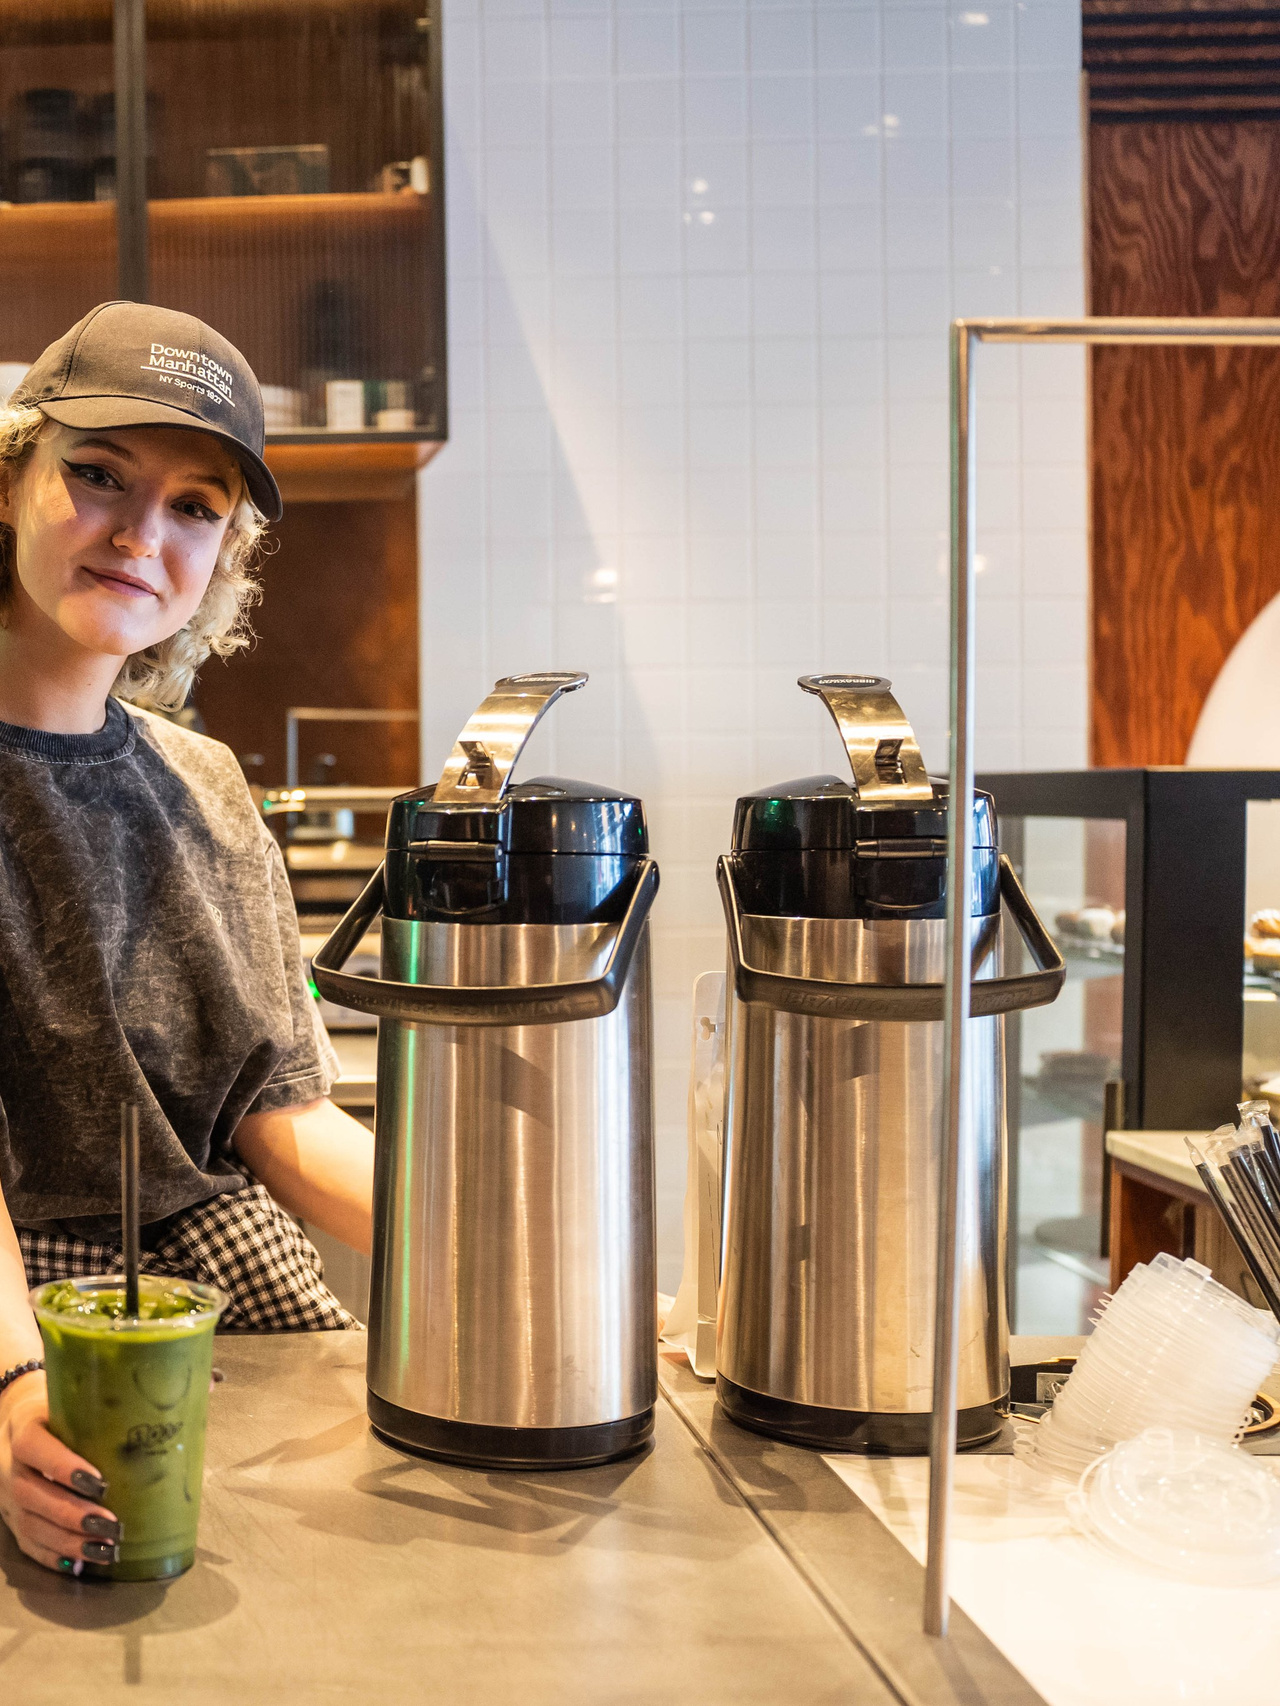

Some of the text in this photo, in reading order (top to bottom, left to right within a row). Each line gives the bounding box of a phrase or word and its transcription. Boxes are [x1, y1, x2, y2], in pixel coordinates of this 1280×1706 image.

[148, 355, 232, 398] Manhattan
[150, 343, 233, 385] Downtown
[159, 374, 222, 405] NY Sports 1927
